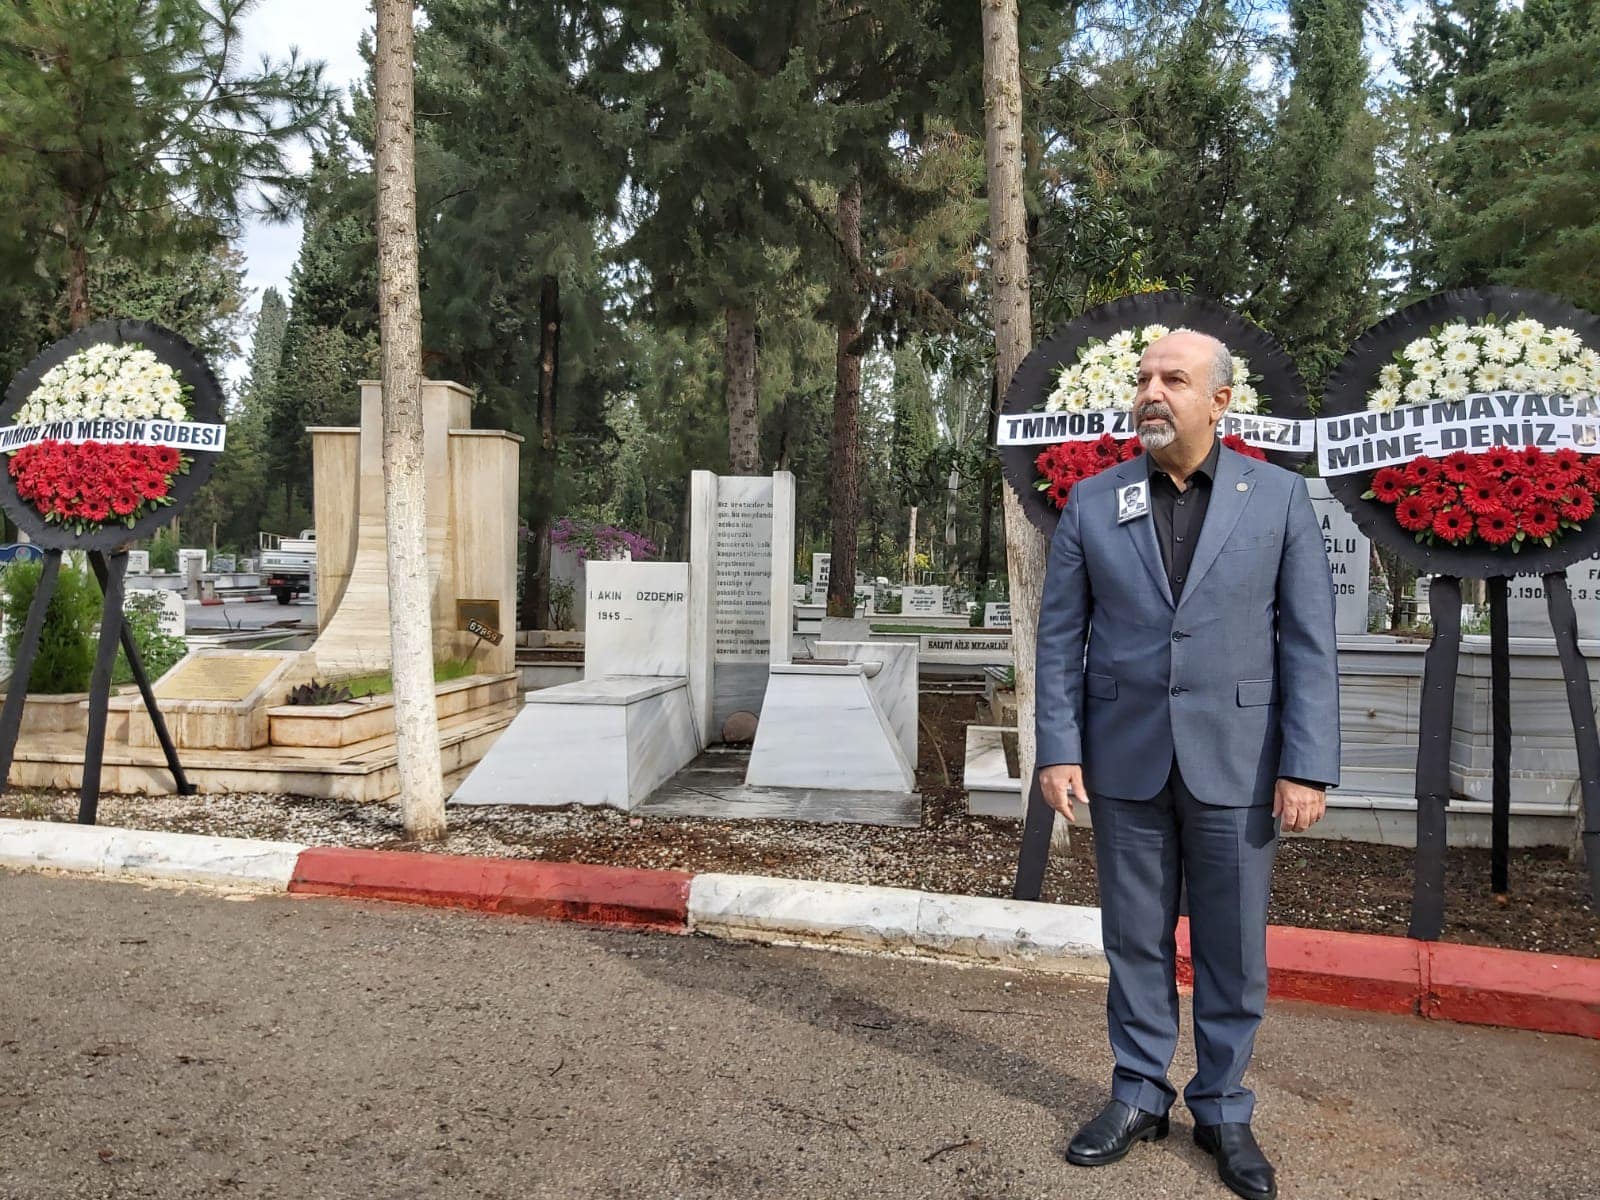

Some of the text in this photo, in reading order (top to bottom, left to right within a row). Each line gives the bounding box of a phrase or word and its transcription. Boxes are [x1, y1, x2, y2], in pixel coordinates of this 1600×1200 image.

[41, 421, 73, 440] ZMO
[1006, 413, 1104, 439] TMMOB
[1328, 417, 1600, 470] MİNE-DENİZ-U
[1323, 535, 1356, 553] ĞLU
[598, 591, 621, 601] AKIN
